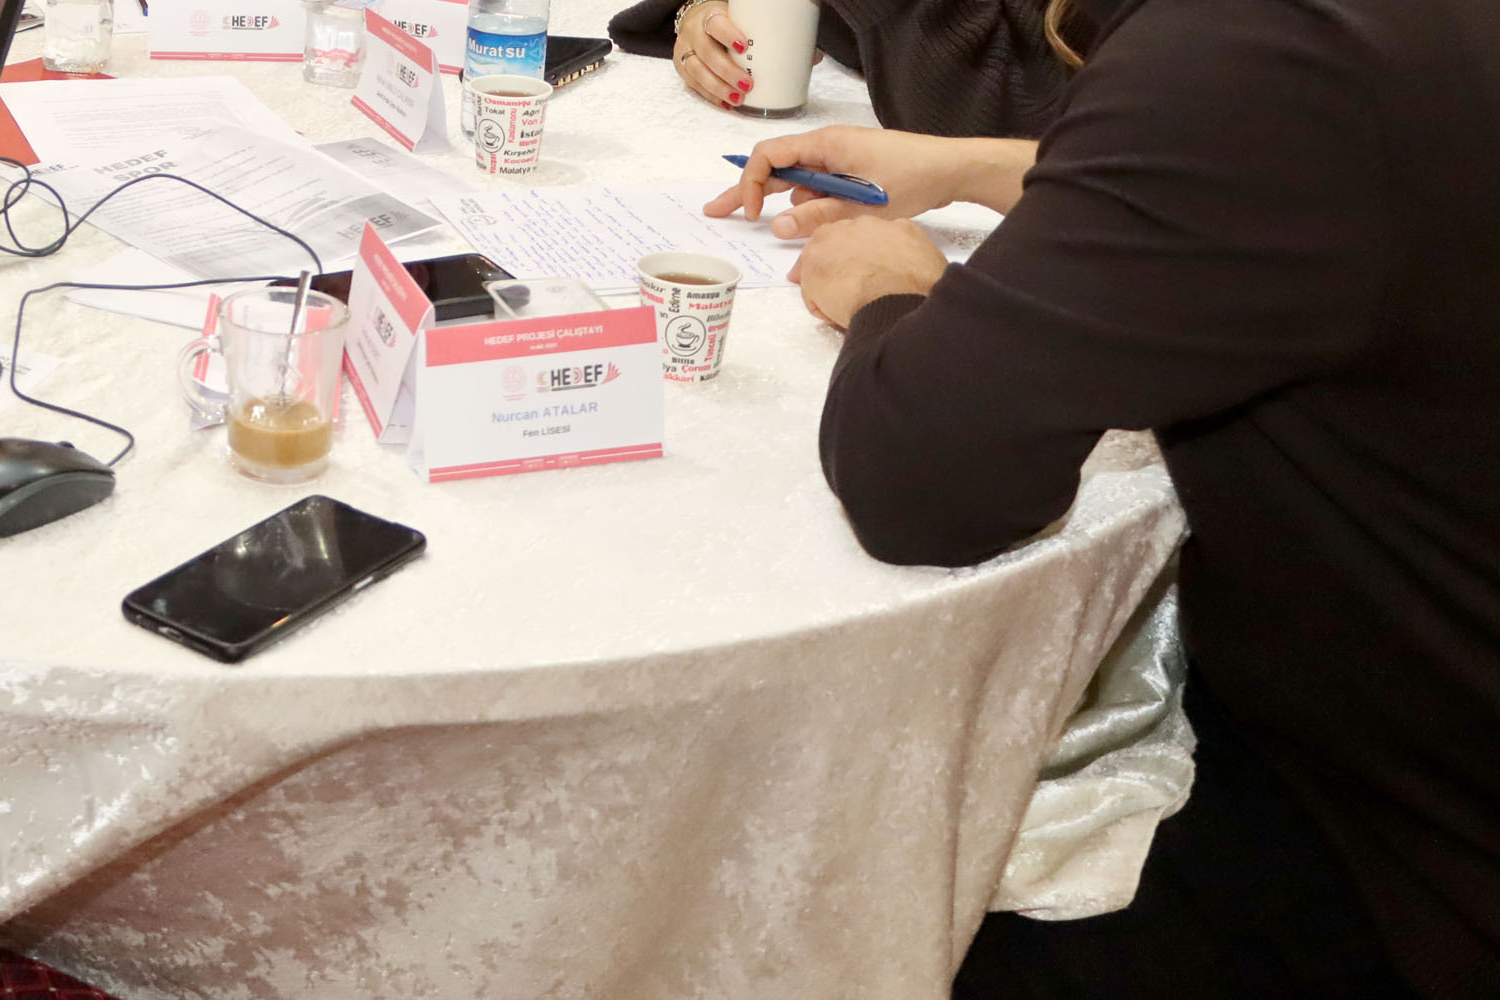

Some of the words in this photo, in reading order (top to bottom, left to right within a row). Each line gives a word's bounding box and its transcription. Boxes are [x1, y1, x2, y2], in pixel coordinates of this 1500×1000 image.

[231, 15, 269, 28] HEDEF
[468, 37, 503, 58] Murat
[505, 47, 525, 59] su
[485, 107, 506, 116] Tokat
[92, 149, 168, 175] HEDEF
[112, 161, 179, 181] SPOR
[499, 166, 532, 176] Malatya
[668, 287, 682, 313] Edirne
[686, 291, 721, 300] Amasya
[550, 364, 604, 387] HEDEF
[491, 409, 539, 424] Nurcan
[542, 401, 599, 418] ATALAR
[522, 428, 539, 438] Fen
